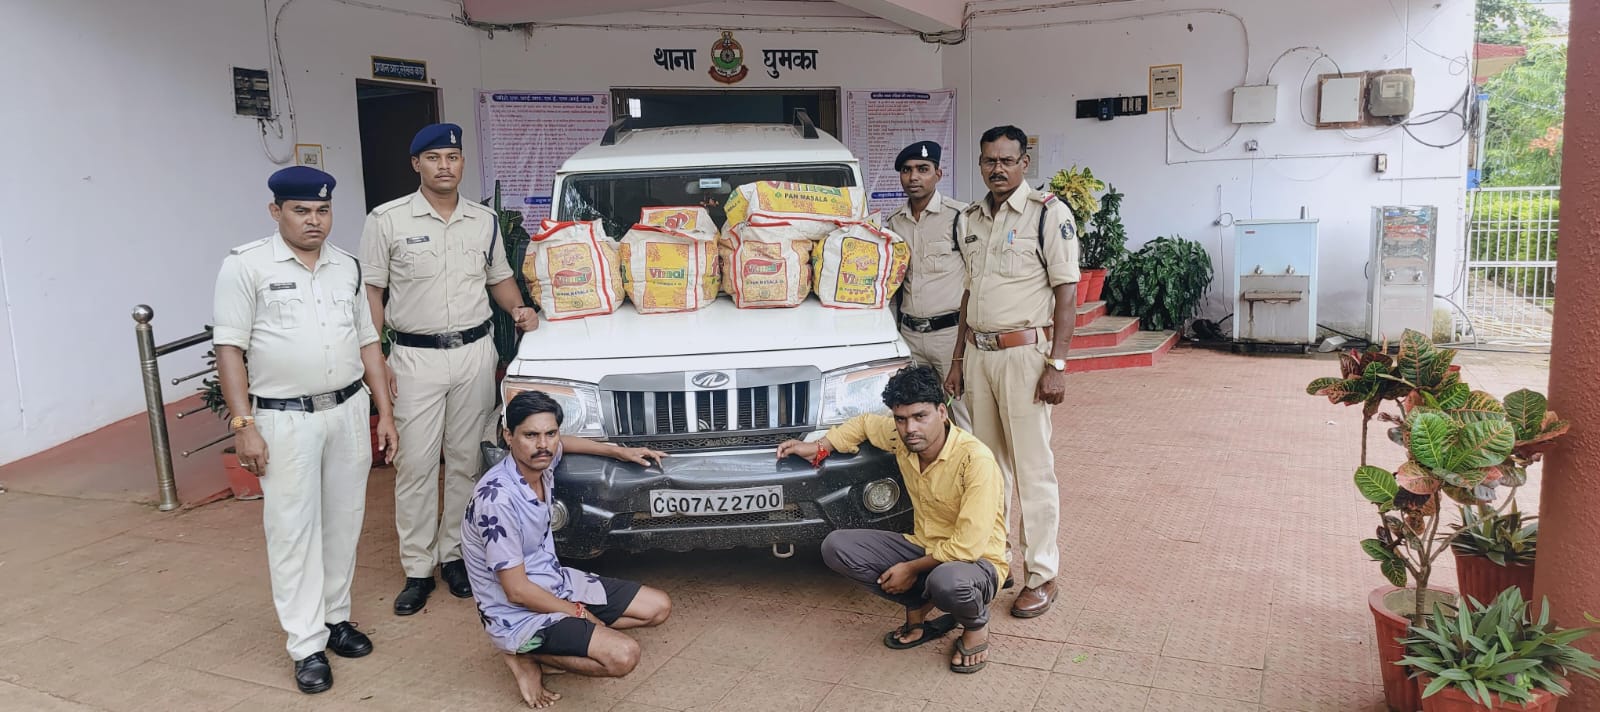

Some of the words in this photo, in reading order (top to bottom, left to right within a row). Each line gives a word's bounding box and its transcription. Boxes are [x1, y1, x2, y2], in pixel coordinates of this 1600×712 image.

[653, 48, 697, 71] थाना
[762, 49, 819, 78] घुमका
[784, 192, 799, 200] PAN
[800, 194, 828, 203] MASALA
[648, 268, 685, 279] Vimal
[653, 492, 781, 513] CG07AZ2700
